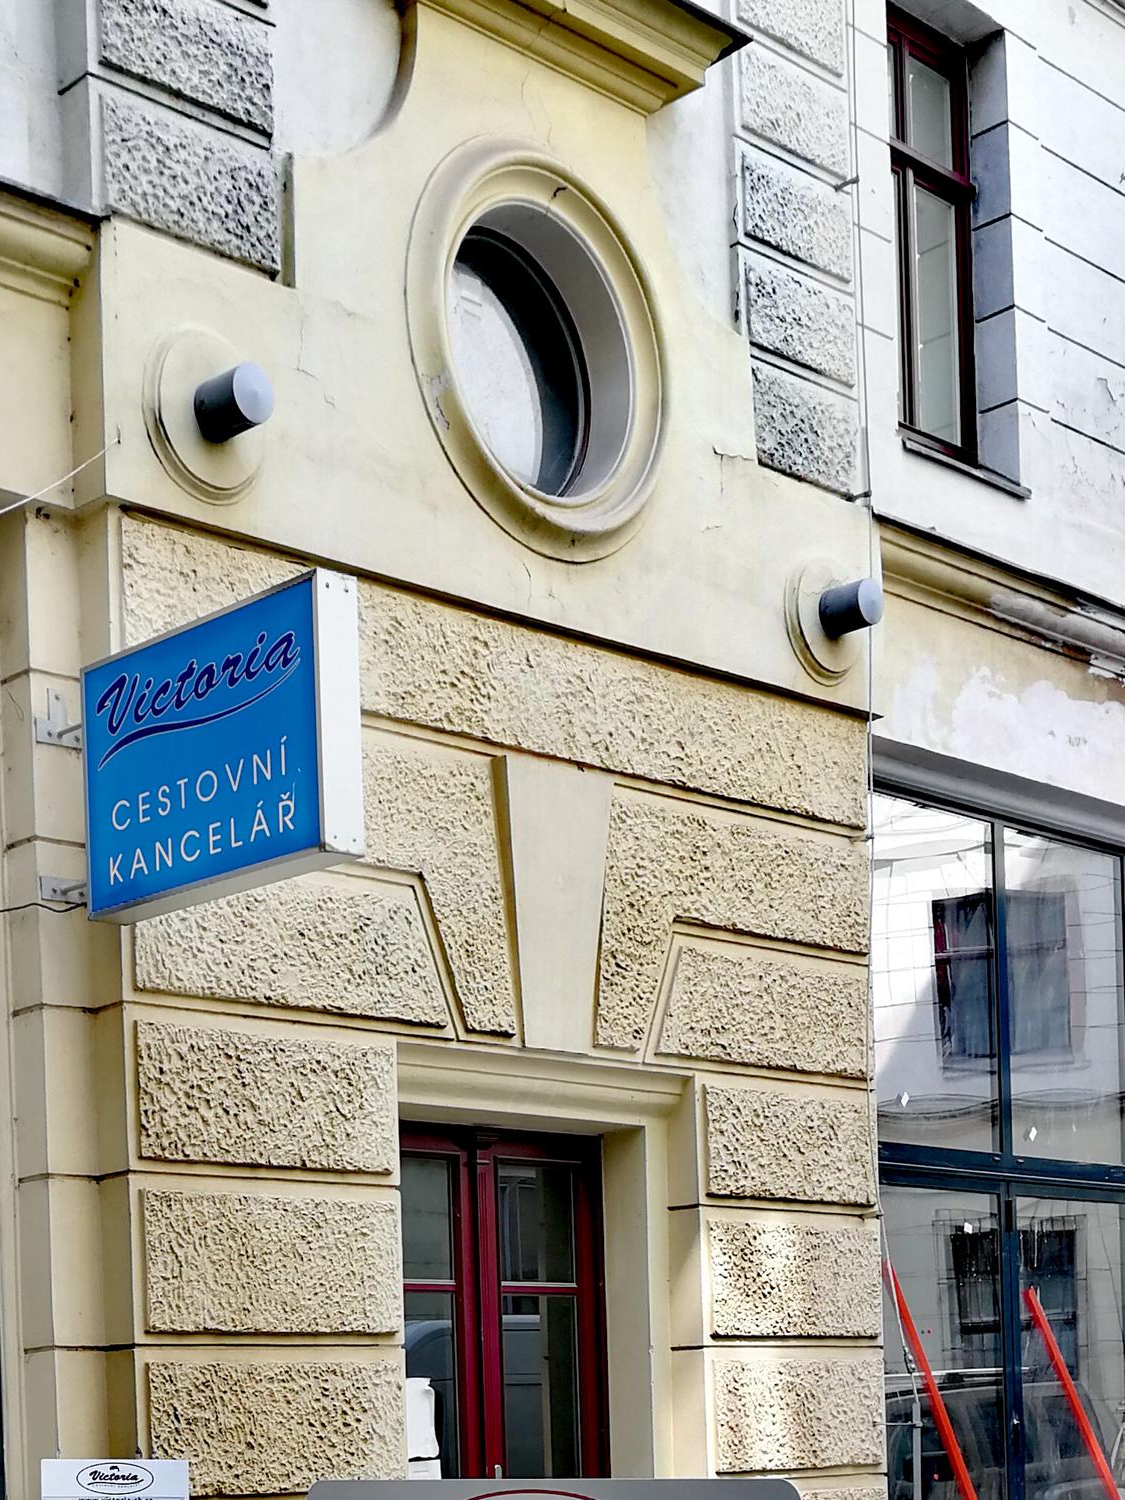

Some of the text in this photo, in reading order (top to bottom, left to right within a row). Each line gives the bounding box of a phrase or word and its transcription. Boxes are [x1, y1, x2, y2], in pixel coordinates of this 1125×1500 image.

[95, 630, 301, 737] Victoria
[111, 736, 288, 831] CESTOVNÍ
[108, 791, 296, 886] KANCELÁŘ
[89, 1469, 140, 1482] Victoria
